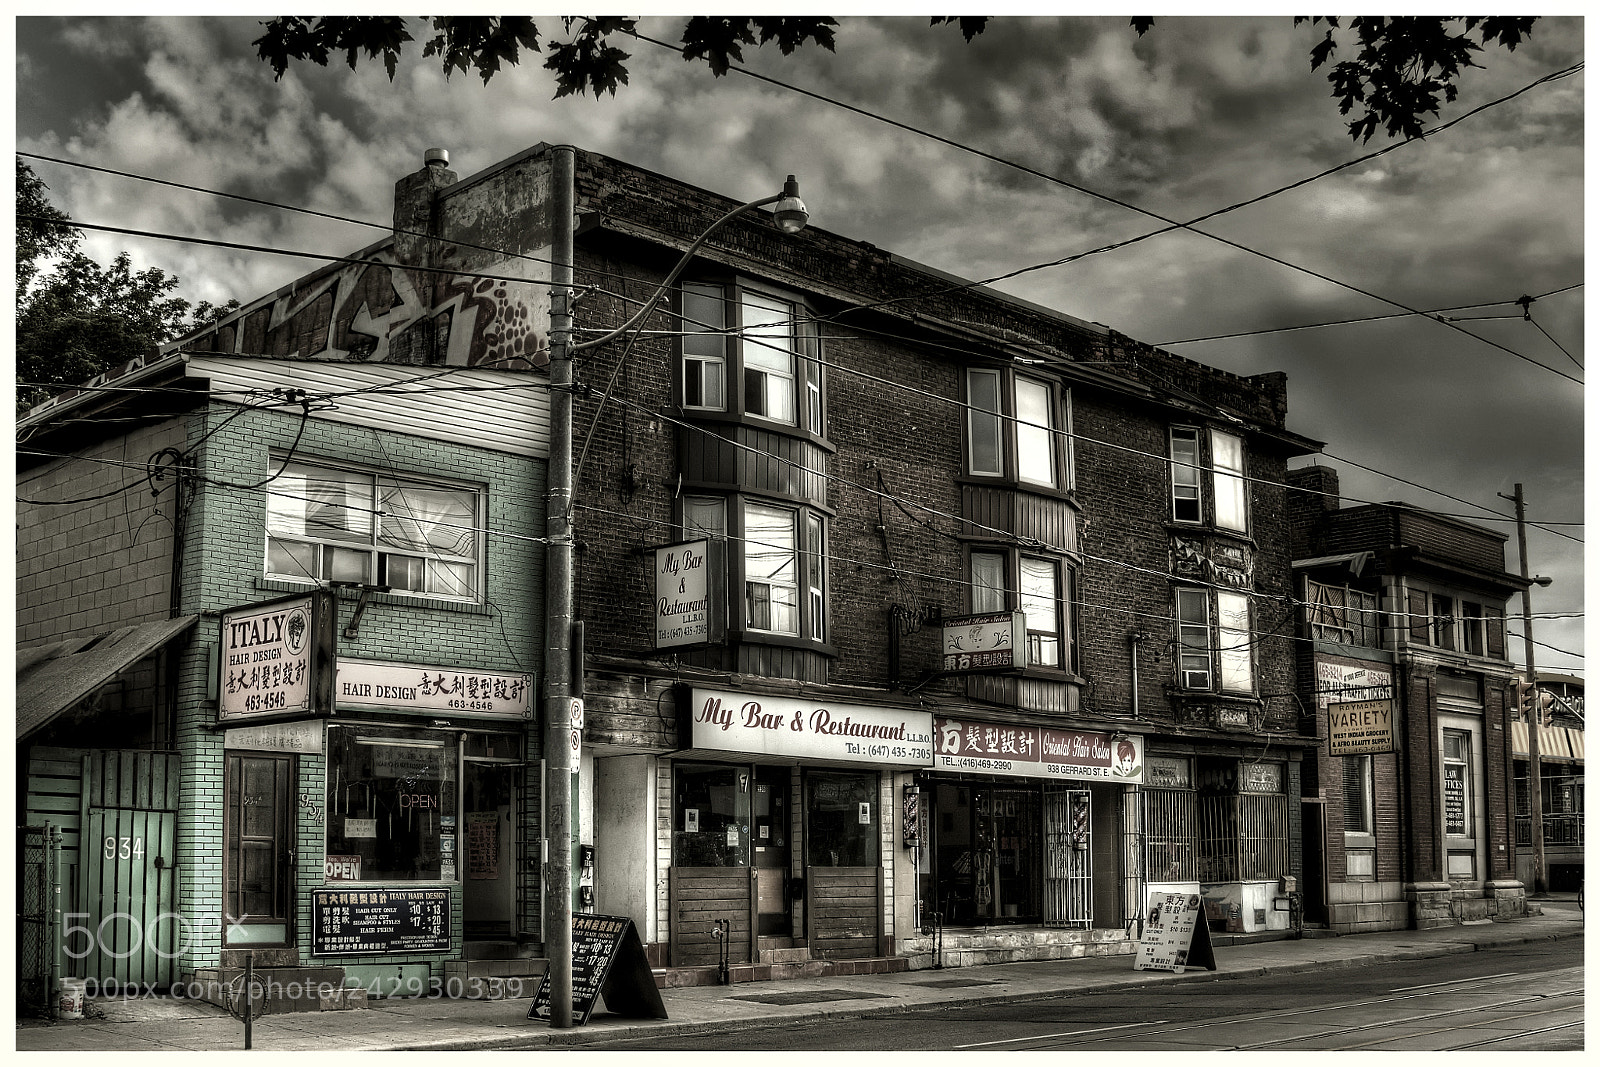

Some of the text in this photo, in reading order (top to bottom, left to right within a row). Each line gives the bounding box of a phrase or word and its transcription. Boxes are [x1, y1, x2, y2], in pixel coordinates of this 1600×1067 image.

[661, 550, 703, 577] My Bar
[678, 577, 686, 594] &
[658, 595, 708, 617] Restaurant
[230, 614, 286, 649] ITALY
[229, 648, 282, 666] HAIR DESIGN
[342, 682, 372, 697] HAIR
[376, 686, 417, 700] DESIGN
[448, 700, 493, 711] 463-4546
[695, 697, 735, 731] My
[741, 701, 785, 730] Bar
[790, 710, 804, 732] &
[809, 709, 907, 741] Restaurant
[1331, 709, 1388, 727] VARIETY
[1042, 731, 1110, 760] Oriental Hair Salon
[1371, 737, 1391, 745] SUPPLY
[845, 743, 861, 754] Tel
[868, 744, 890, 758] (647)
[891, 746, 907, 758] 435
[908, 748, 931, 760] -7305
[400, 794, 437, 808] OPEN
[105, 836, 145, 860] 934
[325, 862, 360, 880] OPEN
[425, 892, 446, 900] DESIGN
